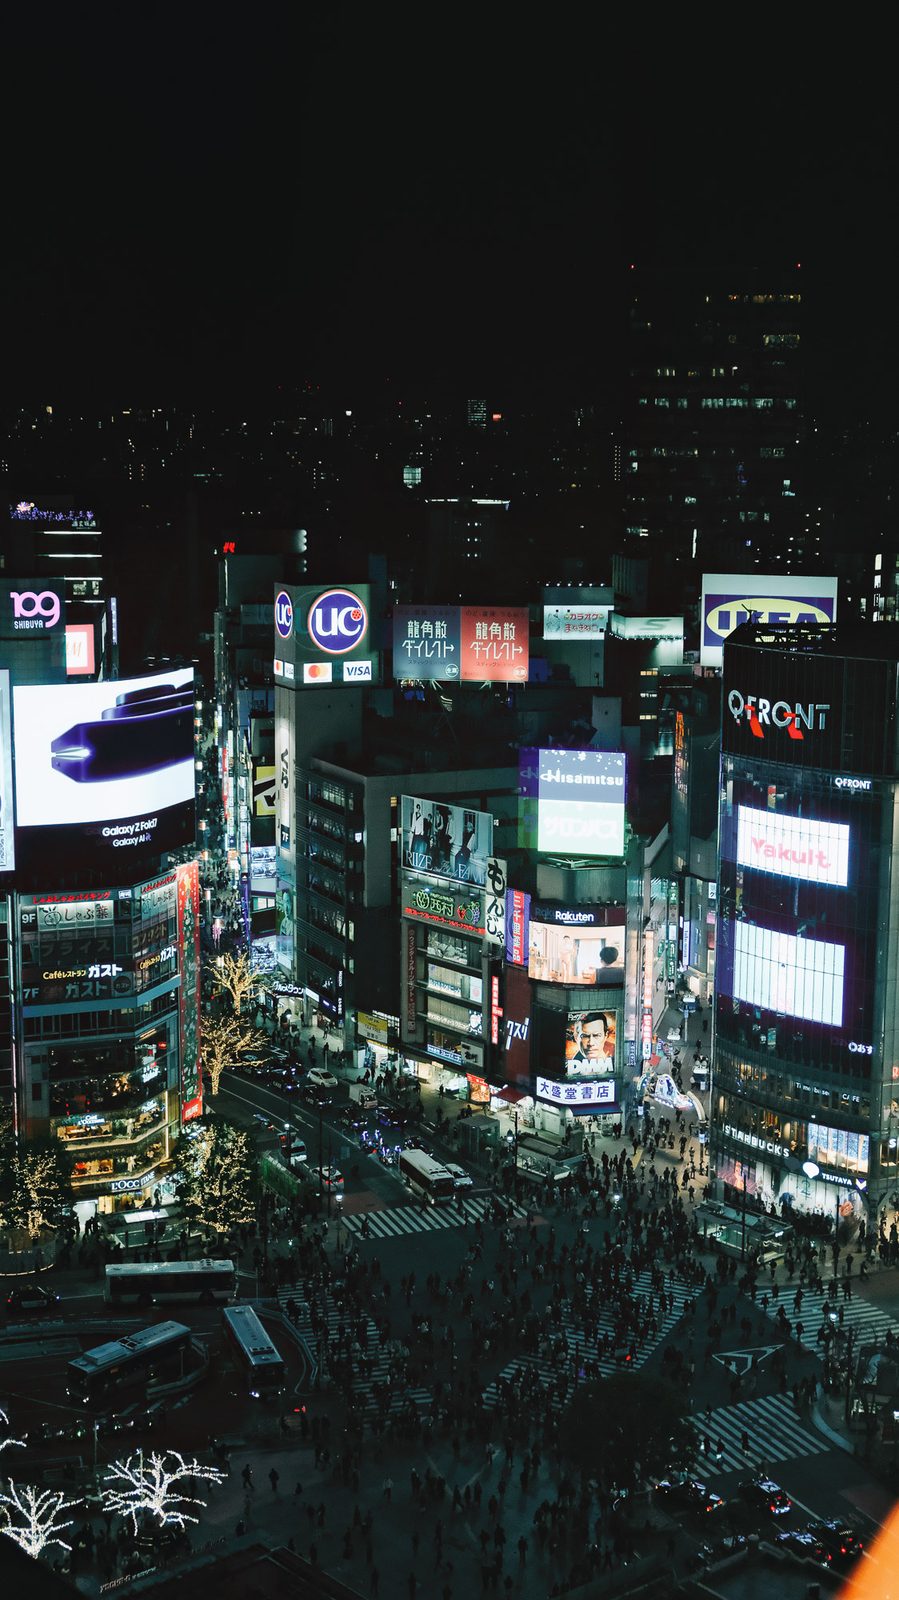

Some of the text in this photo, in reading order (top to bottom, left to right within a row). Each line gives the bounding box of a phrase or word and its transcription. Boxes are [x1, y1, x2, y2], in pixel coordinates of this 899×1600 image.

[10, 591, 60, 628] 109
[277, 603, 292, 627] UC
[14, 620, 43, 629] SHIBUYA
[316, 607, 361, 636] UC
[408, 620, 447, 639] 龍角散
[718, 611, 818, 630] IKEA
[475, 622, 516, 640] 龍角散
[402, 640, 455, 658] ダイレクト
[470, 641, 523, 660] ダイレクト
[346, 666, 370, 676] VISA
[728, 690, 830, 730] QFRONT
[540, 768, 624, 786] Hisamitsu
[835, 777, 871, 790] QFRONT
[102, 818, 158, 837] Galaxy Z Fold7
[282, 831, 289, 842] 7F
[112, 834, 146, 847] Galaxy AI
[406, 850, 432, 870] RIIZE
[751, 837, 831, 869] Yakult
[430, 898, 454, 917] 西村
[488, 859, 505, 943] もんじゃ
[22, 913, 36, 924] 9F
[65, 904, 109, 921] しゃぶ葉
[555, 911, 594, 922] Rakuten
[160, 945, 177, 962] ガスト
[88, 963, 123, 979] ガスト
[23, 988, 39, 999] 7F
[66, 981, 107, 999] ガスト
[567, 1057, 614, 1075] DMM
[540, 1081, 610, 1100] 大盛堂書店
[724, 1124, 790, 1158] STARBUCKS
[821, 1172, 853, 1186] TSUTAYA
